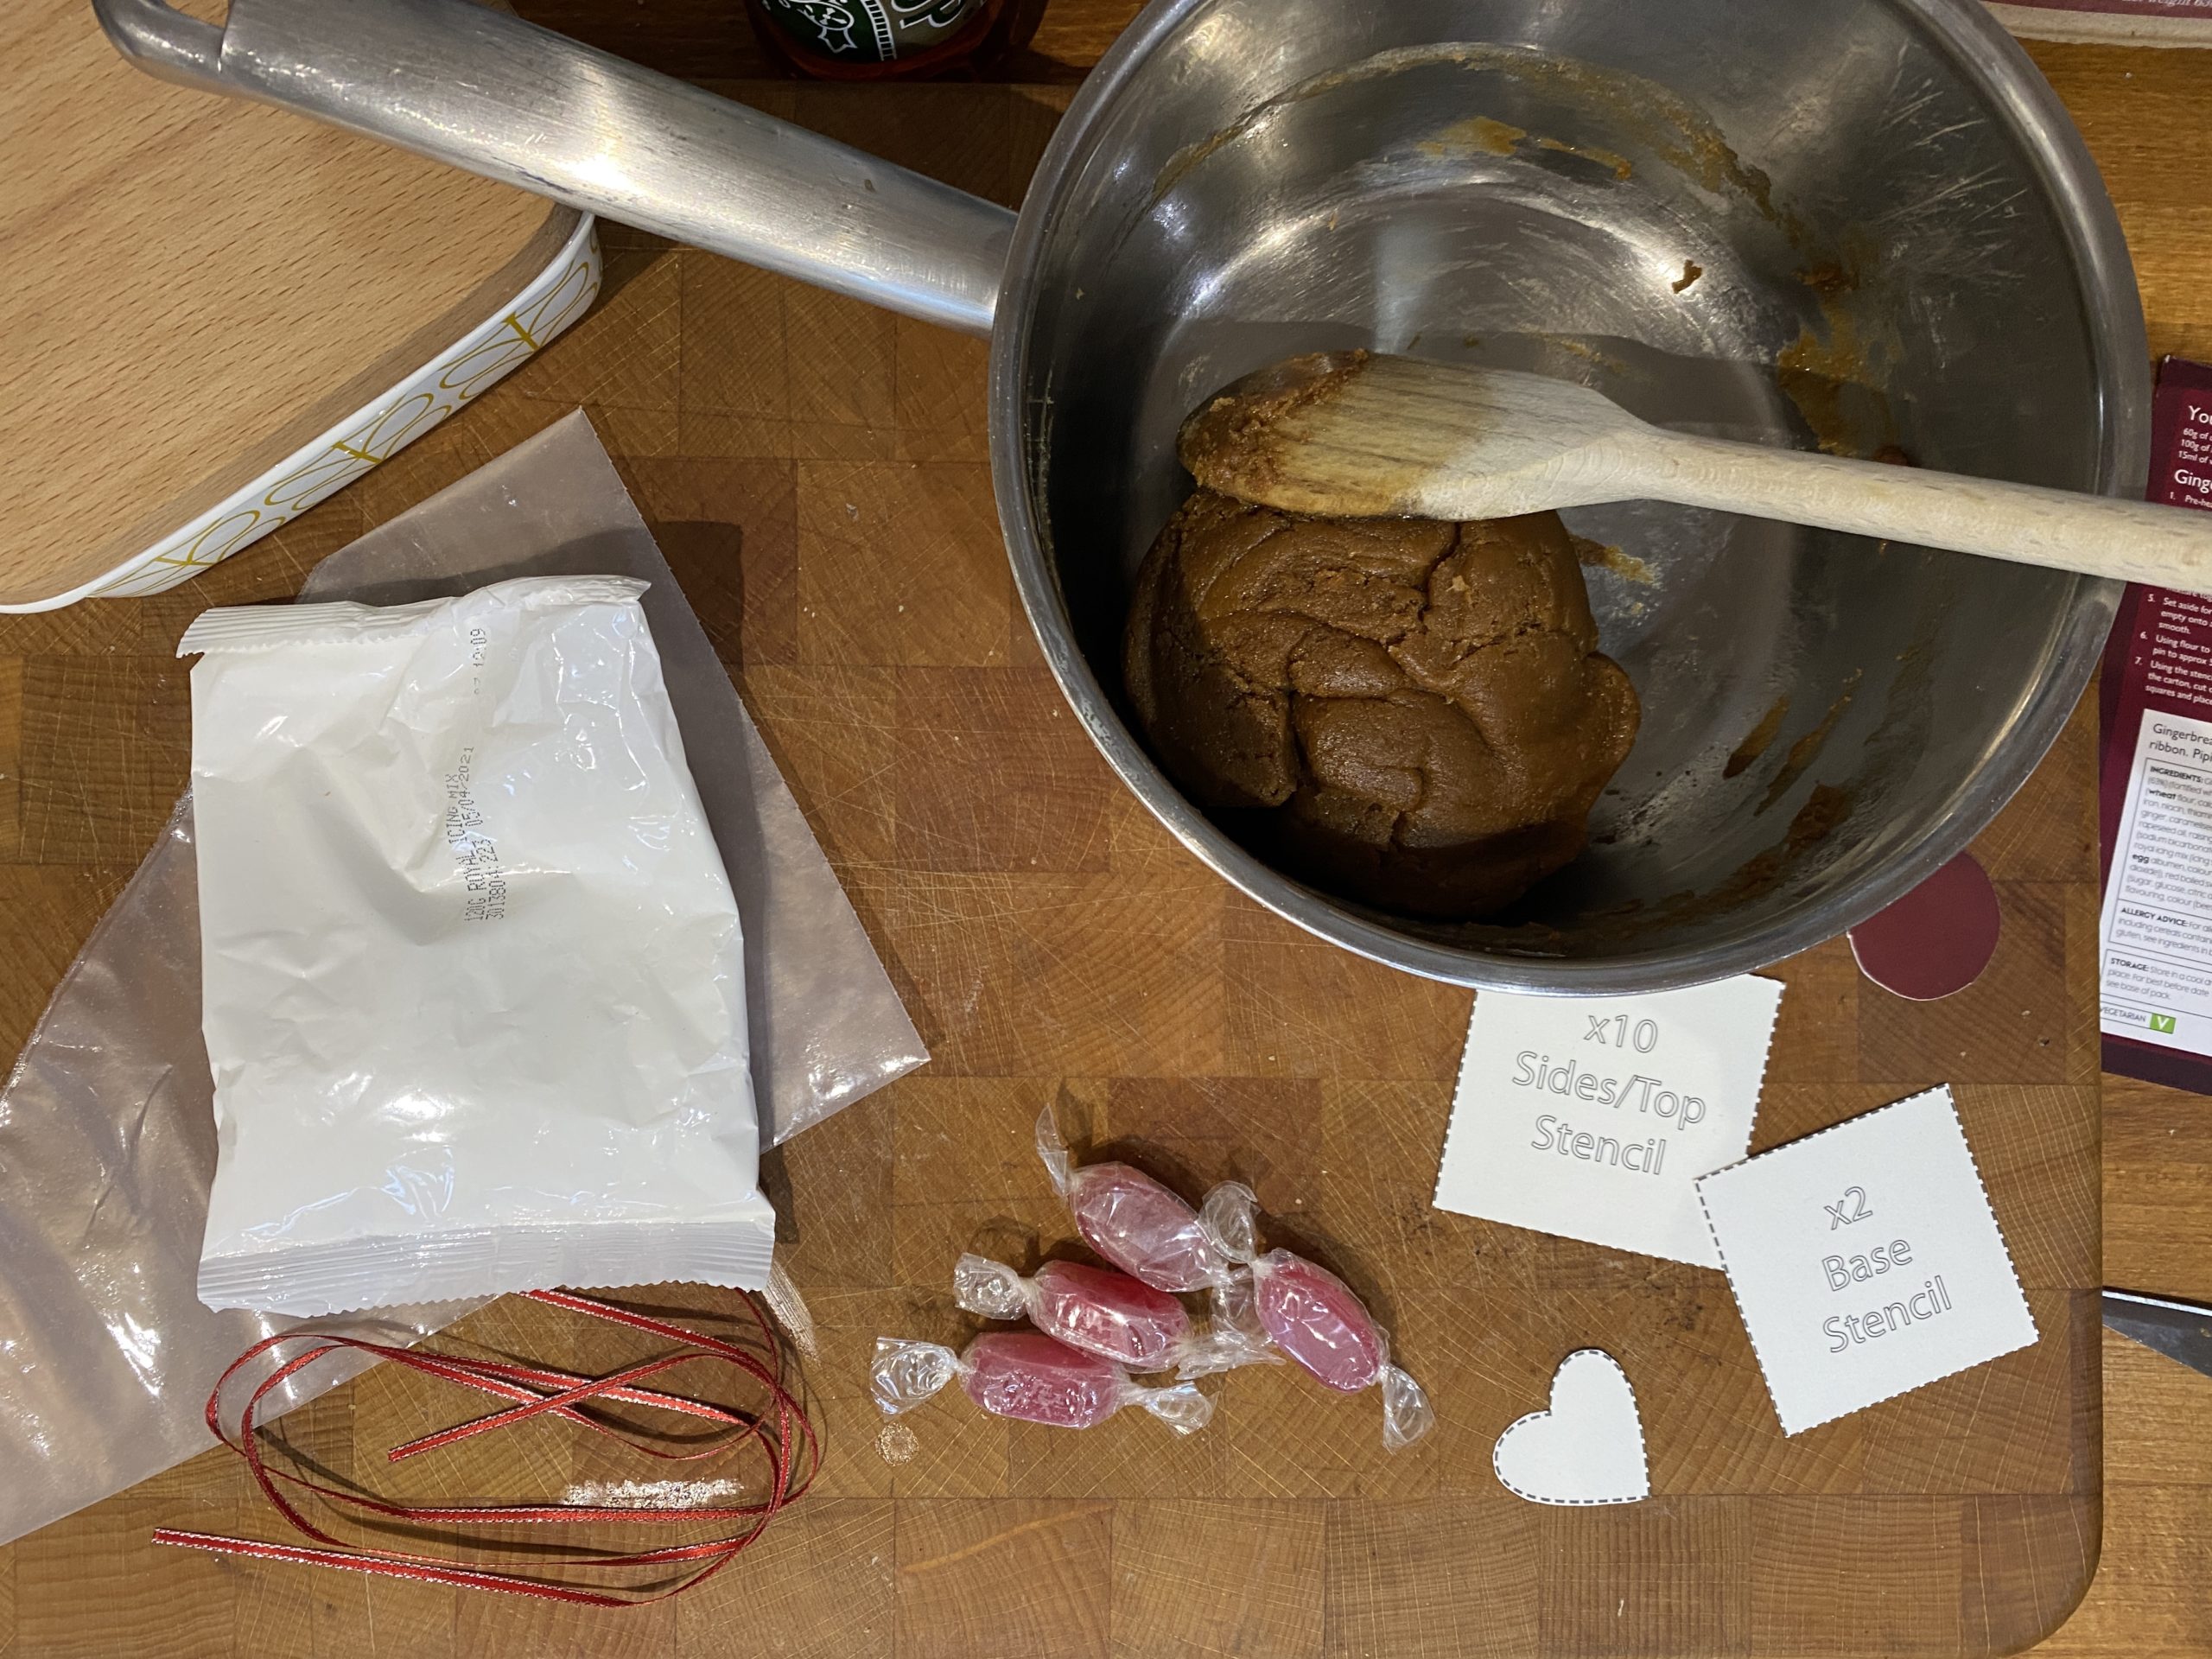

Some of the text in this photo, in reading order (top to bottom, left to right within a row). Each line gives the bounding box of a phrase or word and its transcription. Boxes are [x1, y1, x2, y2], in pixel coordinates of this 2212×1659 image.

[2164, 597, 2177, 607] Set
[2178, 603, 2199, 612] aside
[2161, 611, 2187, 623] empty
[2188, 617, 2209, 626] onto
[2158, 622, 2191, 634] smooth.
[2156, 634, 2178, 648] Using
[2180, 640, 2199, 651] flour
[2150, 660, 2173, 674] Using
[2175, 666, 2188, 675] the
[2179, 654, 2207, 664] approx
[2148, 672, 2162, 682] the
[2164, 677, 2191, 689] carton,
[2145, 685, 2176, 696] squares
[2177, 692, 2193, 701] and
[2149, 741, 2188, 757] ribbon.
[2151, 766, 2203, 783] INGREDIENTS:
[444, 772, 460, 799] MIX
[2134, 842, 2154, 853] royal
[2132, 855, 2149, 863] egg
[455, 851, 486, 892] ROYAL
[2167, 895, 2192, 906] colour
[2121, 907, 2156, 919] ALLERGY
[2157, 916, 2190, 927] ADVICE:
[2111, 957, 2149, 971] STORAGE:
[2150, 966, 2171, 977] Store
[2186, 975, 2203, 984] cool
[2120, 982, 2140, 992] base
[2145, 977, 2162, 986] best
[2164, 981, 2190, 992] before
[2191, 988, 2209, 996] date
[1584, 1013, 1658, 1053] x10
[1512, 1051, 1707, 1130] Sides/Top
[1531, 1115, 1668, 1175] Stencil
[1823, 1185, 1874, 1230] x2
[1821, 1236, 1914, 1291] Base
[1822, 1275, 1953, 1354] Stencil
